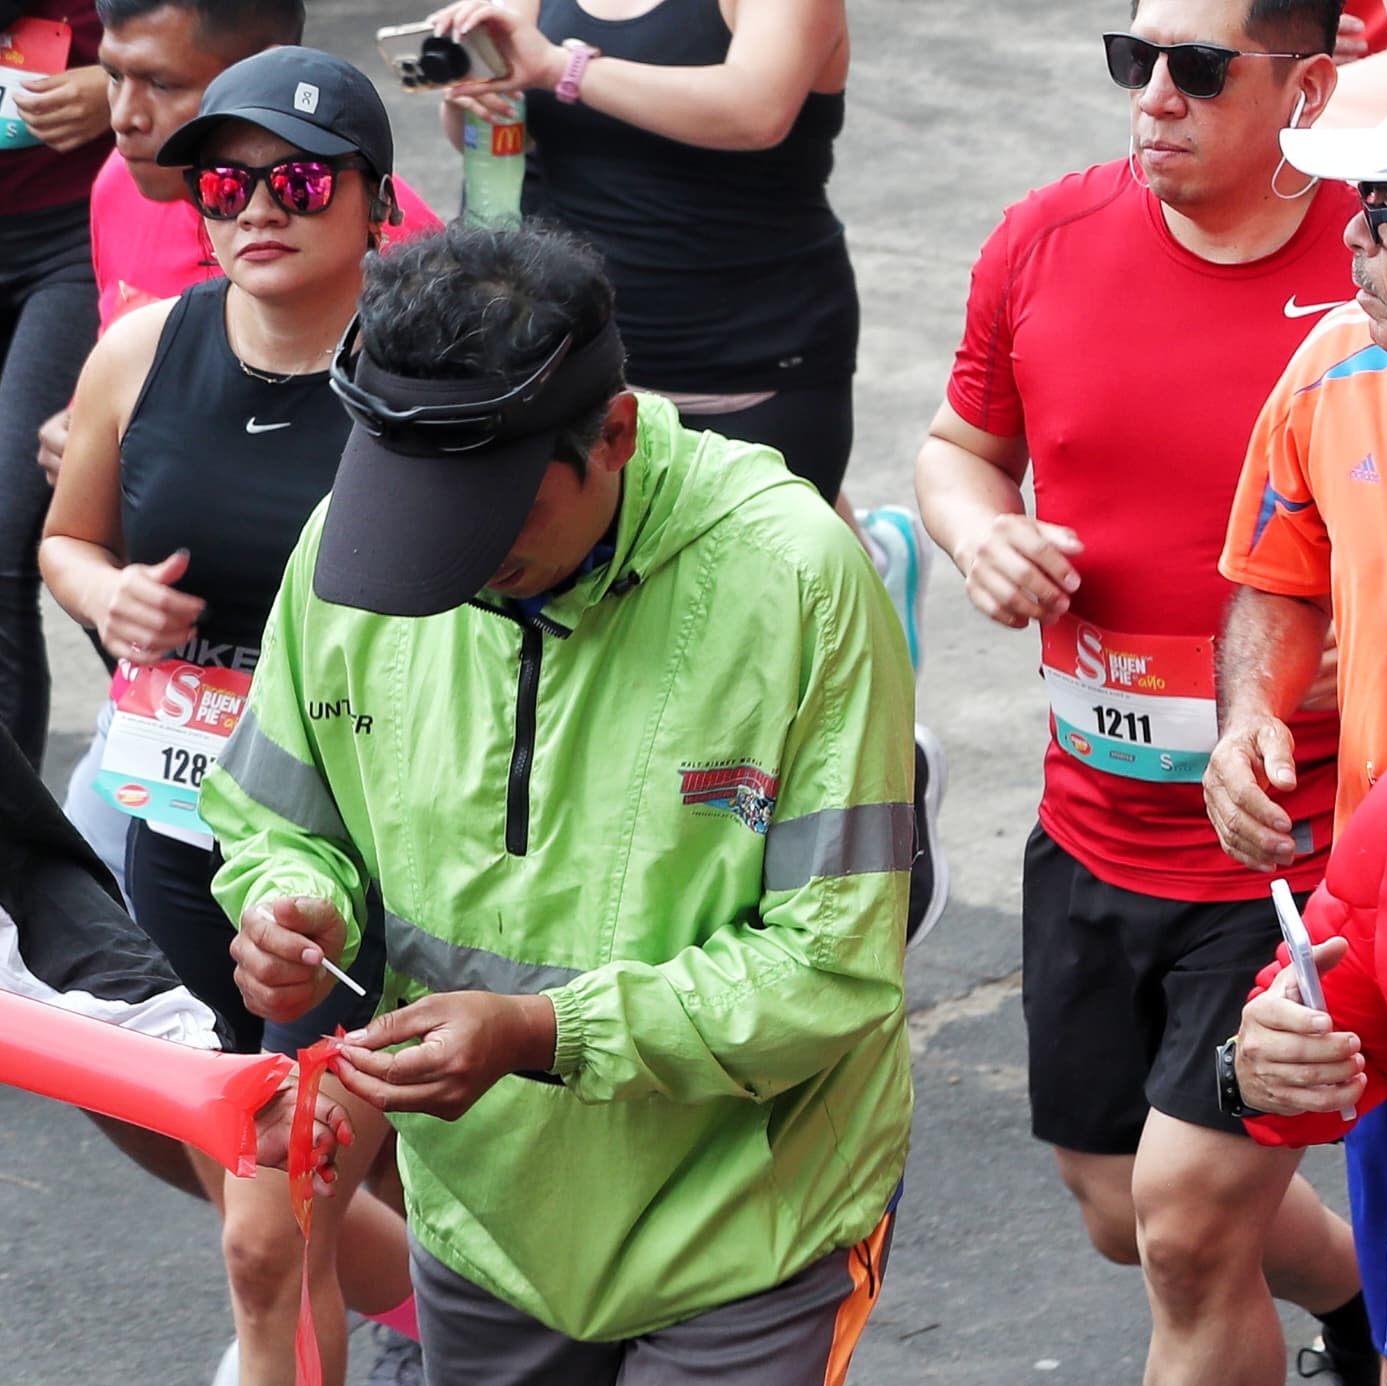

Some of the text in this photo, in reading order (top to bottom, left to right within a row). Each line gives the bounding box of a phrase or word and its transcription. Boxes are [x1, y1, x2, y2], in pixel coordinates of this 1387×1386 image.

[1109, 653, 1147, 675] BUEN
[1110, 670, 1132, 686] PIE
[201, 690, 241, 715] BUEN
[196, 705, 219, 726] PIE
[1092, 704, 1153, 745] 1211
[161, 746, 216, 788] 128
